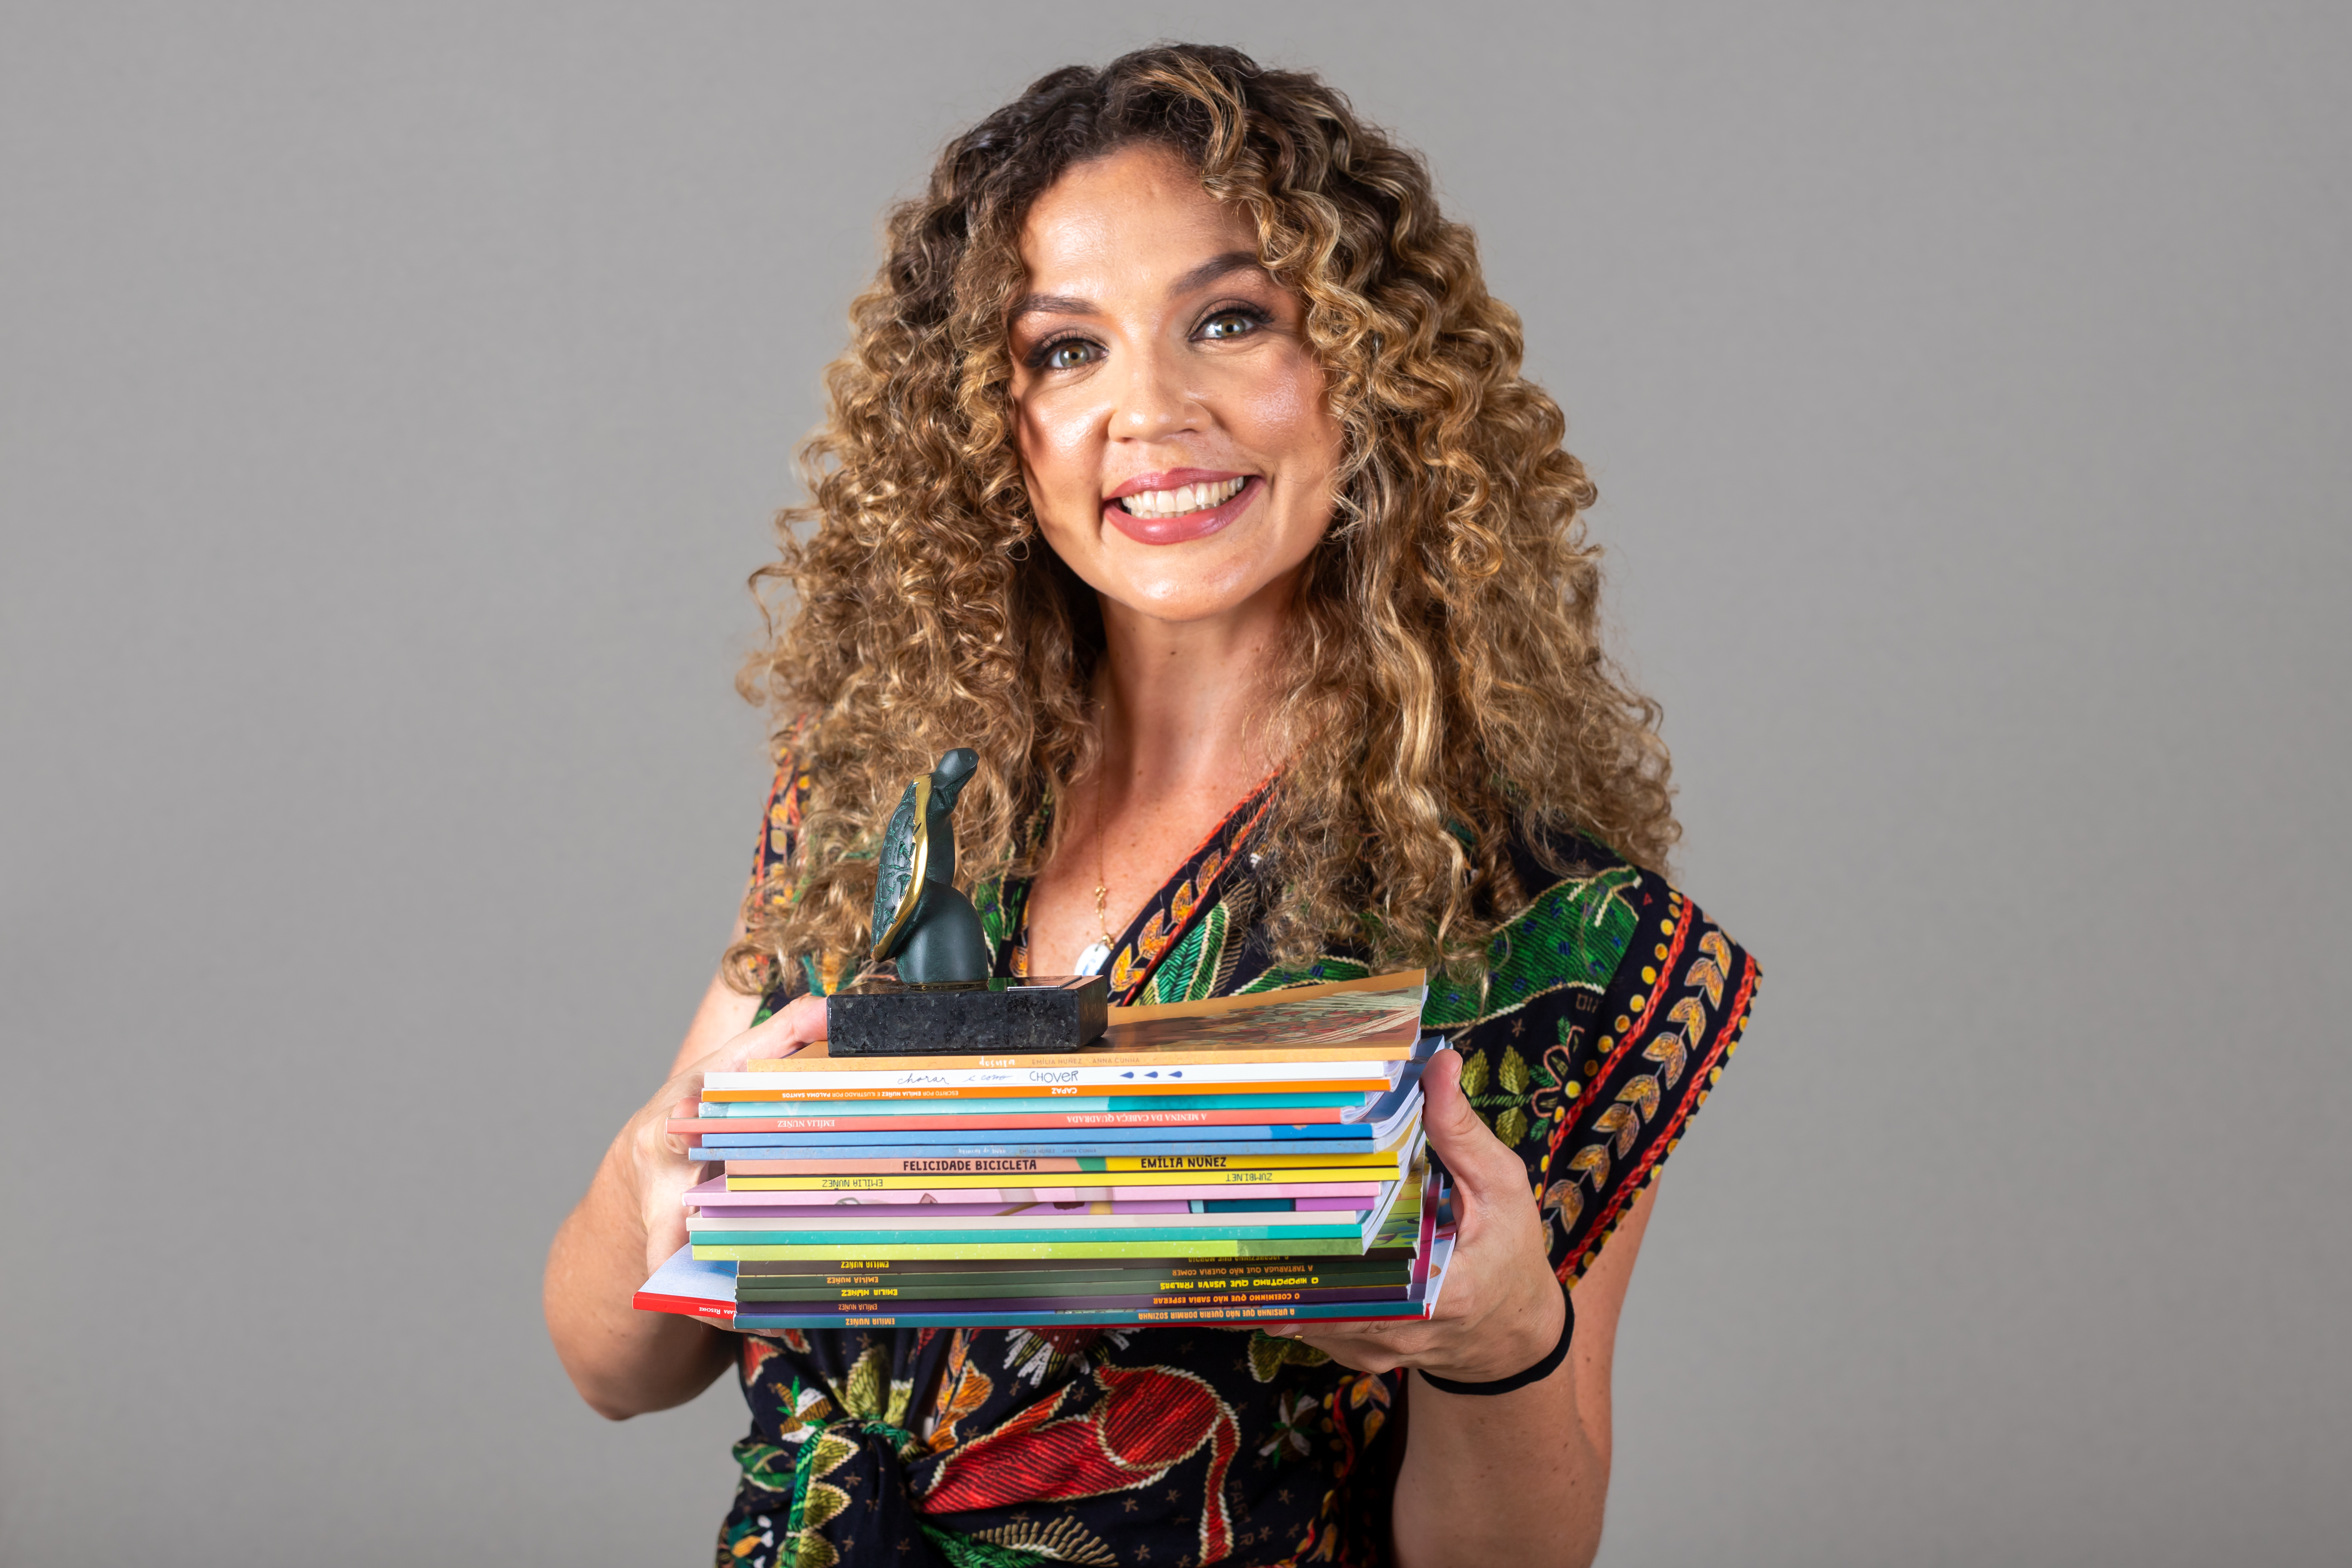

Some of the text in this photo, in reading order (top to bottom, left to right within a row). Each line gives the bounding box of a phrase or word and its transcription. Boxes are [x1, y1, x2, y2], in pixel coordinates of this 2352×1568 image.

[979, 1056, 1015, 1068] doçura
[897, 1073, 950, 1085] chorar
[1067, 1114, 1115, 1123] QUADRADA
[1116, 1113, 1149, 1122] CABEÇA
[777, 1120, 835, 1129] EMÍLIA NUÑEZ
[903, 1159, 1037, 1171] FELICIDADE BICICLETA
[1141, 1156, 1227, 1168] EMÍLIA NUÑEZ
[1226, 1172, 1272, 1182] ZUMBI.NET
[822, 1179, 883, 1190] EMÍLIA NUÑEZ
[841, 1261, 889, 1269] EMÍLIA NUÑEZ
[854, 1276, 878, 1284] EMÍLIA
[1230, 1280, 1249, 1288] QUE
[1160, 1281, 1194, 1290] FRALDAS
[1213, 1296, 1229, 1304] NÃO
[1231, 1294, 1247, 1302] QUE
[1249, 1293, 1292, 1301] COELHINHO
[838, 1303, 878, 1312] EMÍLIA NUÑEZ
[1138, 1312, 1168, 1320] SOZINHA
[1170, 1311, 1198, 1319] DORMIR
[1200, 1309, 1224, 1318] QUERIA
[1225, 1310, 1241, 1319] NÃO
[1242, 1308, 1255, 1317] QUE
[1257, 1308, 1288, 1317] URSINHA
[845, 1318, 895, 1327] EMÍLIA NUÑEZ
